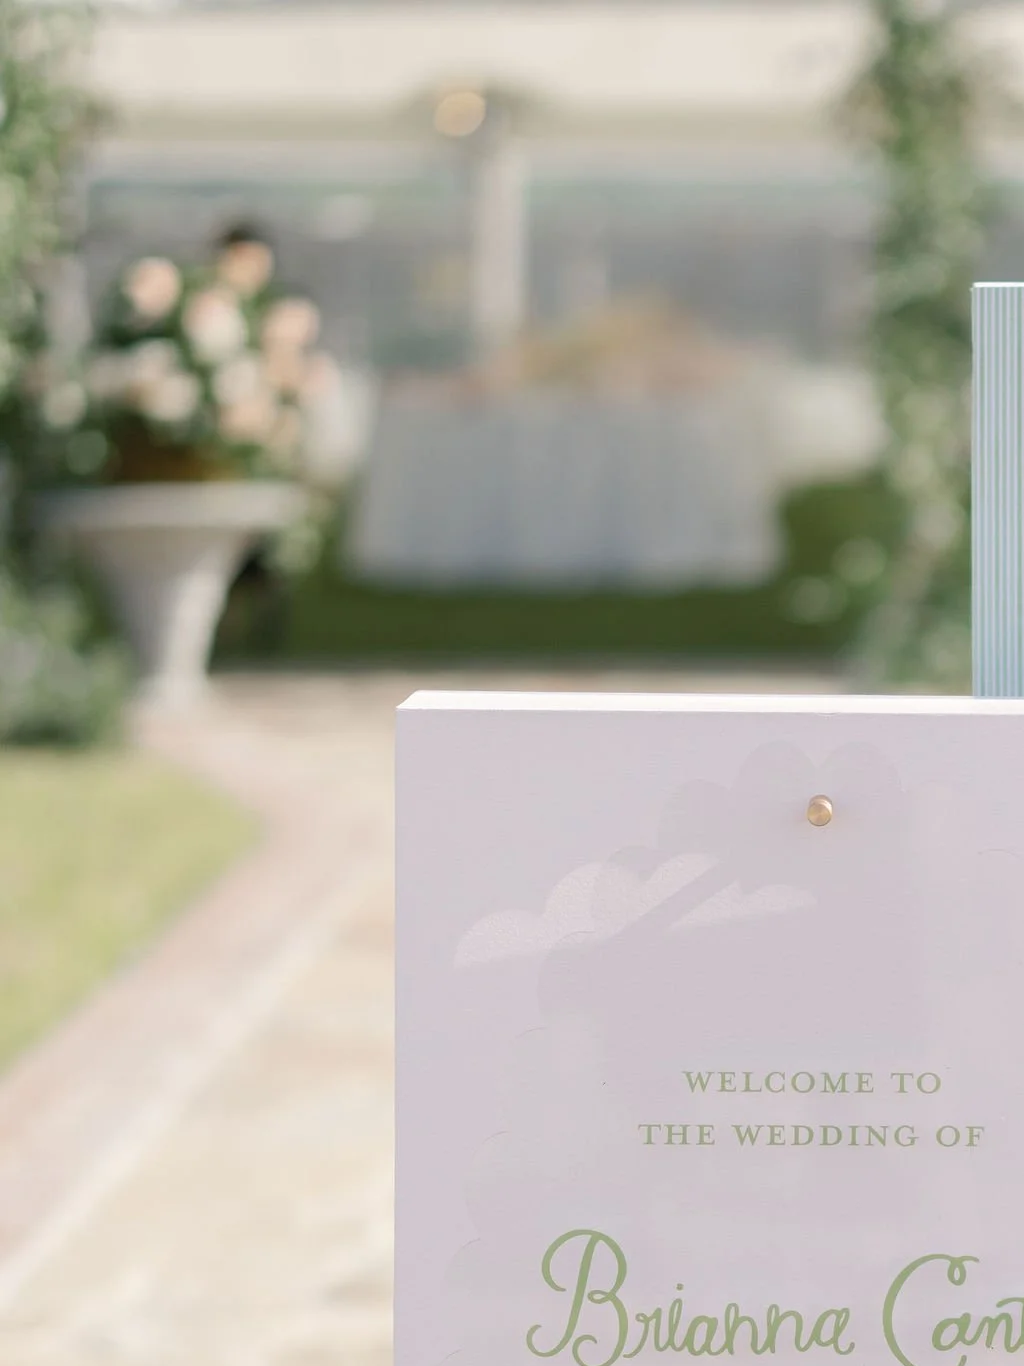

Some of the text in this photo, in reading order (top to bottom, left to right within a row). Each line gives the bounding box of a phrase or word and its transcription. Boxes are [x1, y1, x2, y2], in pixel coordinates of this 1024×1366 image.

[684, 1069, 942, 1096] WELCOME TO
[638, 1122, 987, 1149] THE WEDDING OF
